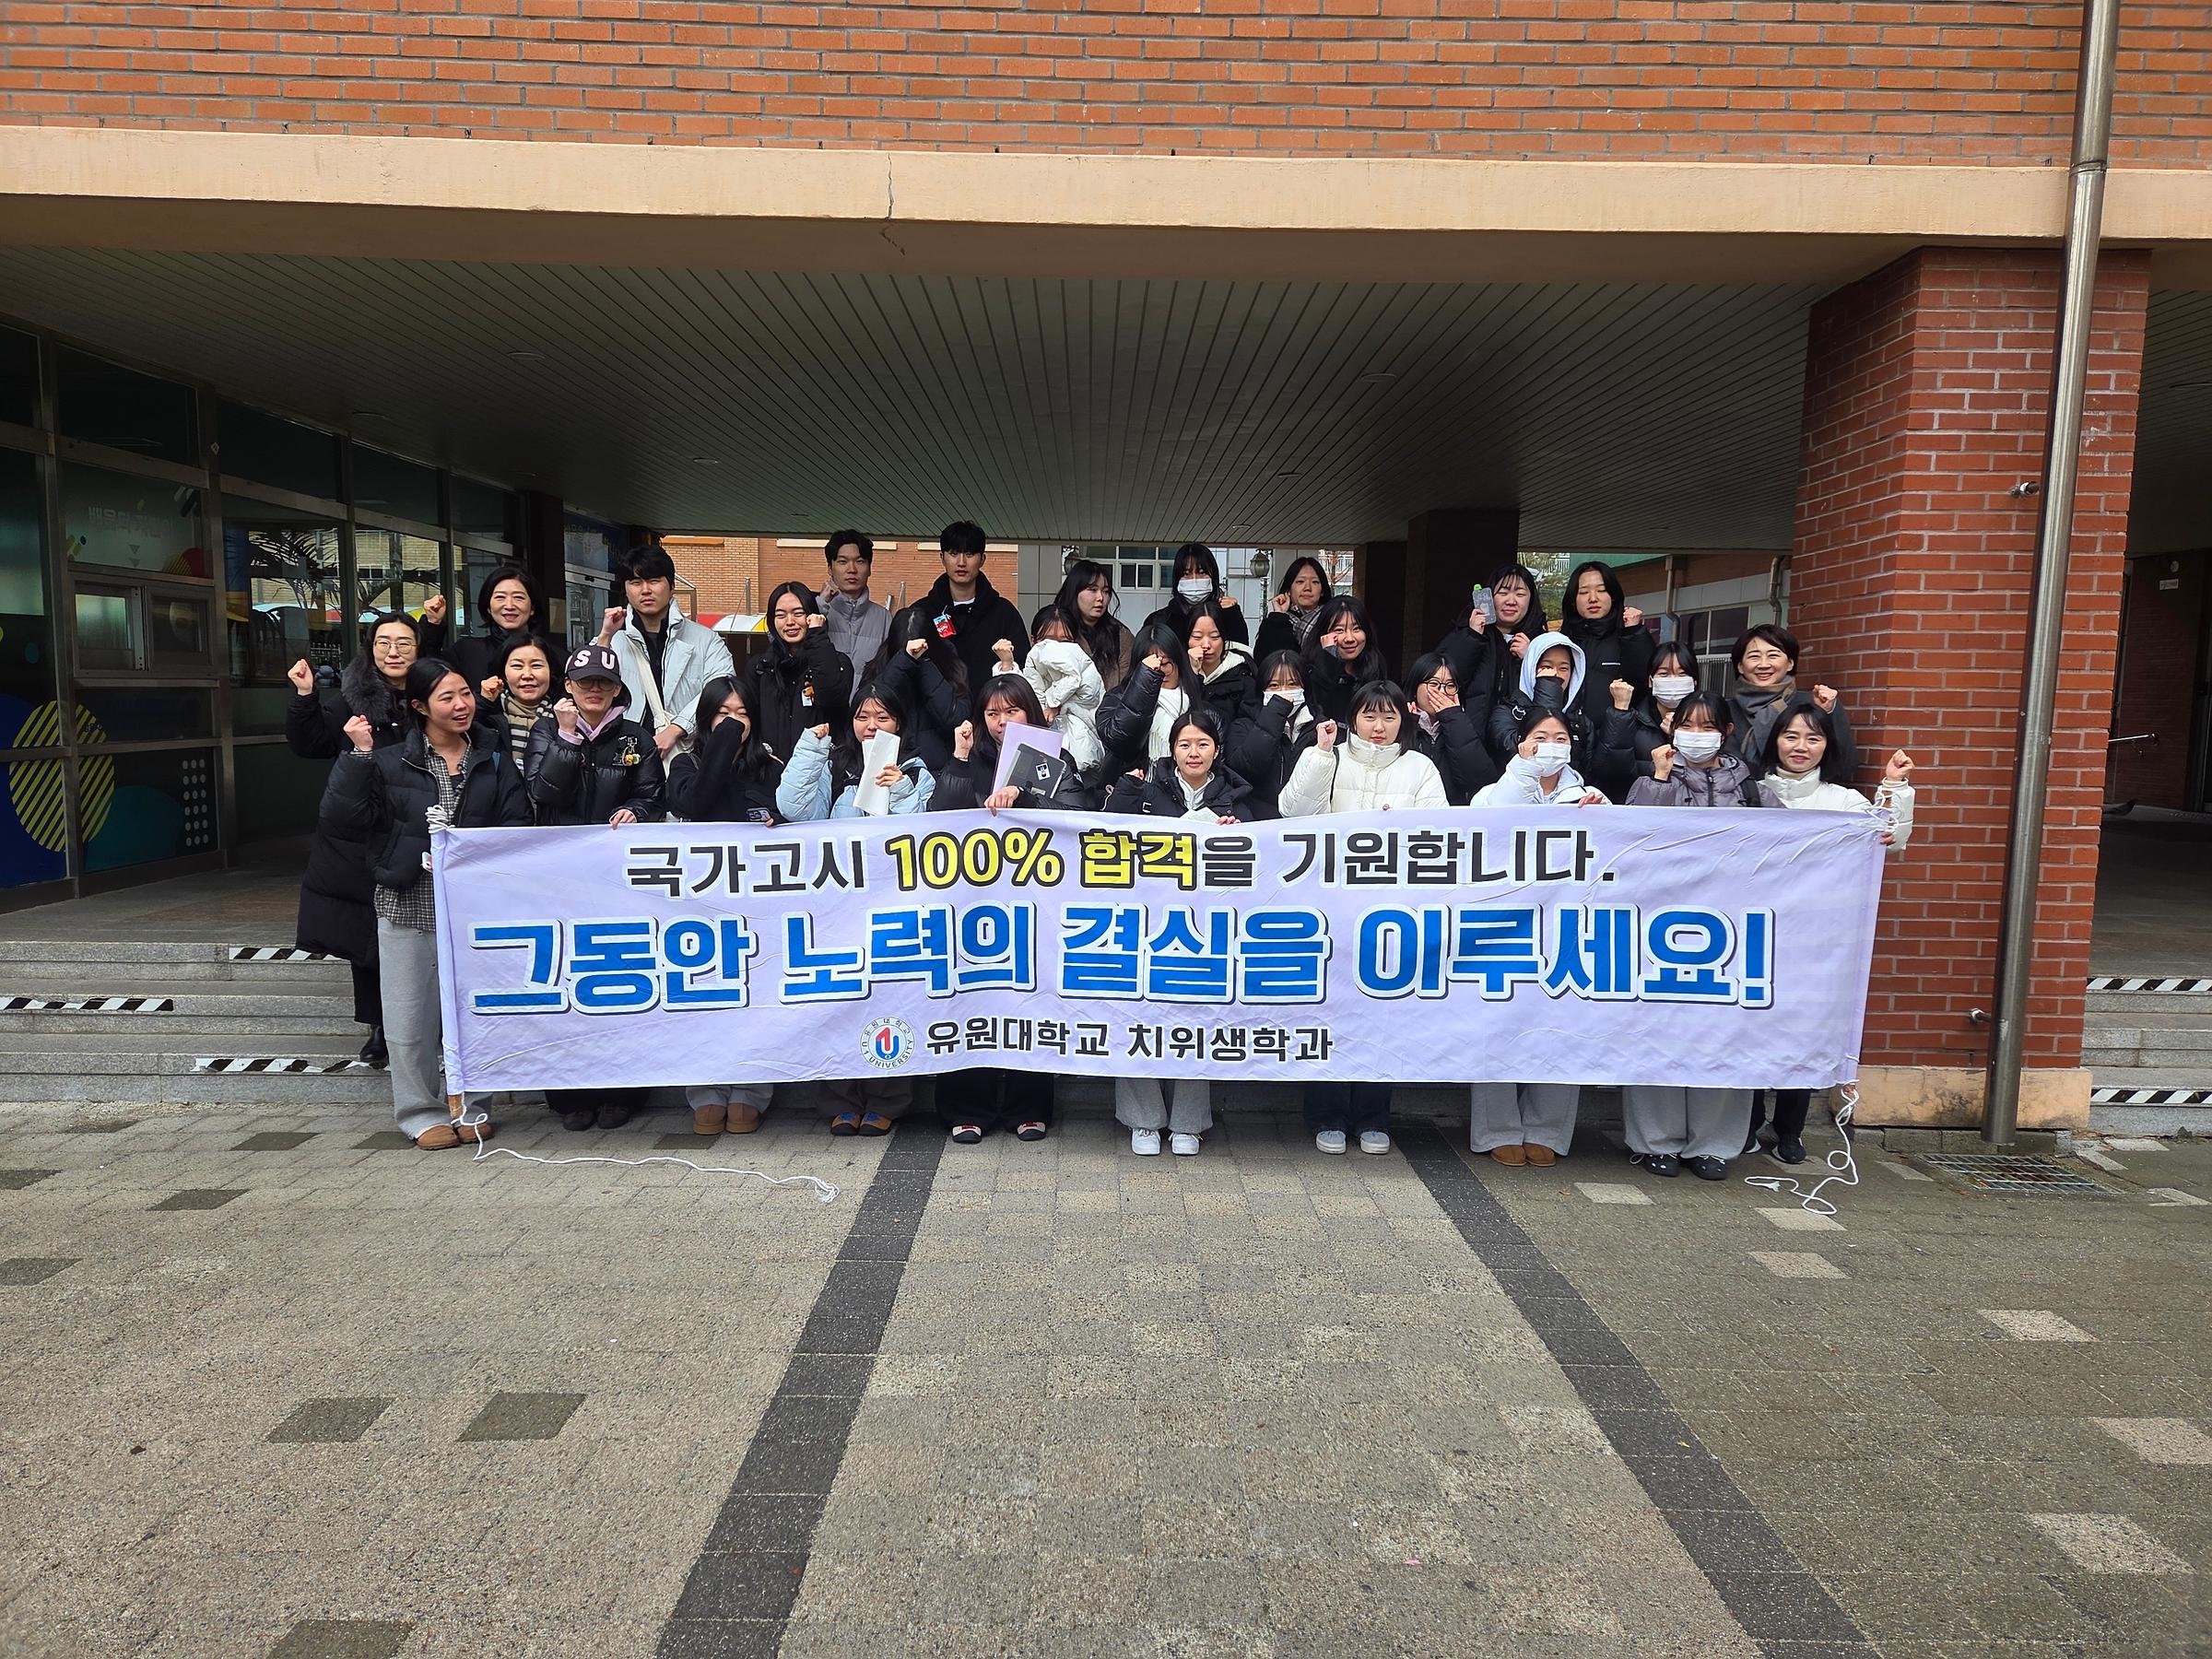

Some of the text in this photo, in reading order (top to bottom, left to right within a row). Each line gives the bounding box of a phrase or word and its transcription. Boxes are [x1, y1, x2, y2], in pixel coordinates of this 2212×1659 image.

[627, 828, 1617, 897] 국가고시 100% 합격을 기원합니다.
[471, 900, 1775, 1013] 그동안 노력의 결실을 이루세요!
[869, 1040, 913, 1068] UNIVERSITY
[926, 1018, 1334, 1063] 유원대학교 치위생학과
